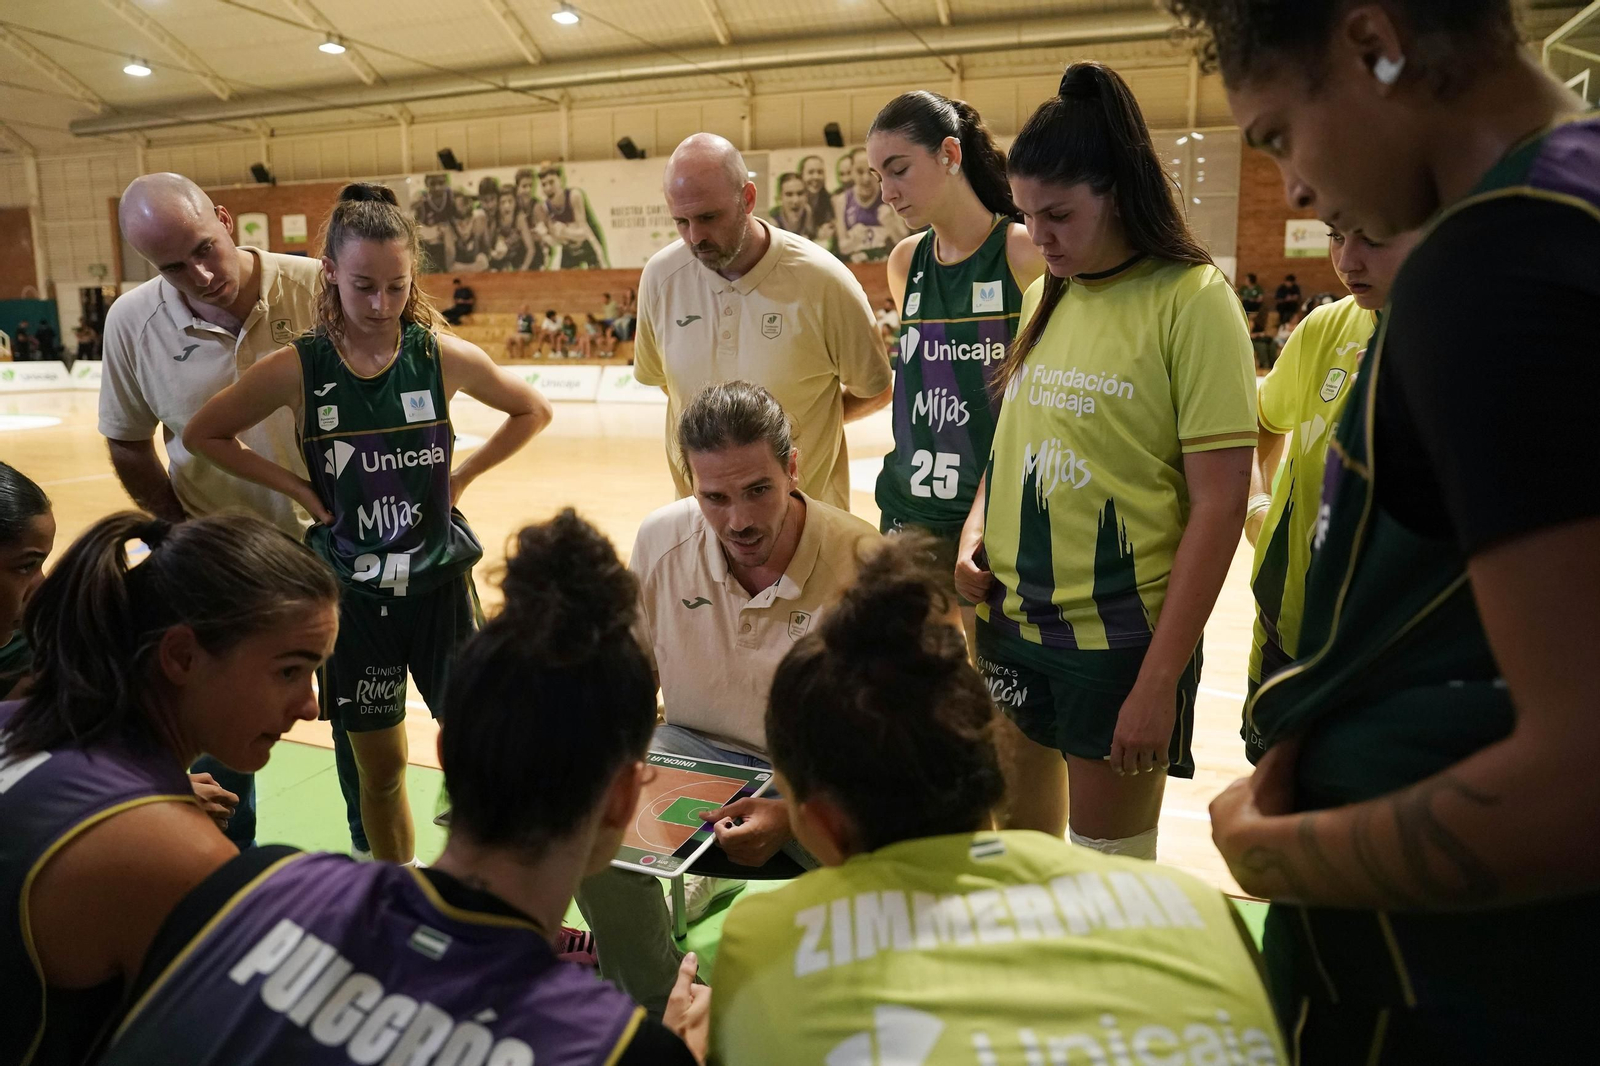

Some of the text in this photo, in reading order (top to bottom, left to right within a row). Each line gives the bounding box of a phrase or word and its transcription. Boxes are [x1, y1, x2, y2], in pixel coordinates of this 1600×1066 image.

[923, 337, 1006, 366] Unicaja
[1028, 386, 1096, 418] Unicaja
[1032, 365, 1135, 400] Fundación
[912, 387, 970, 433] Mijas
[910, 449, 960, 499] 25
[1021, 438, 1092, 496] Mijas
[357, 495, 423, 540] Mijas
[351, 553, 411, 597] 24
[360, 703, 399, 714] DENTAL
